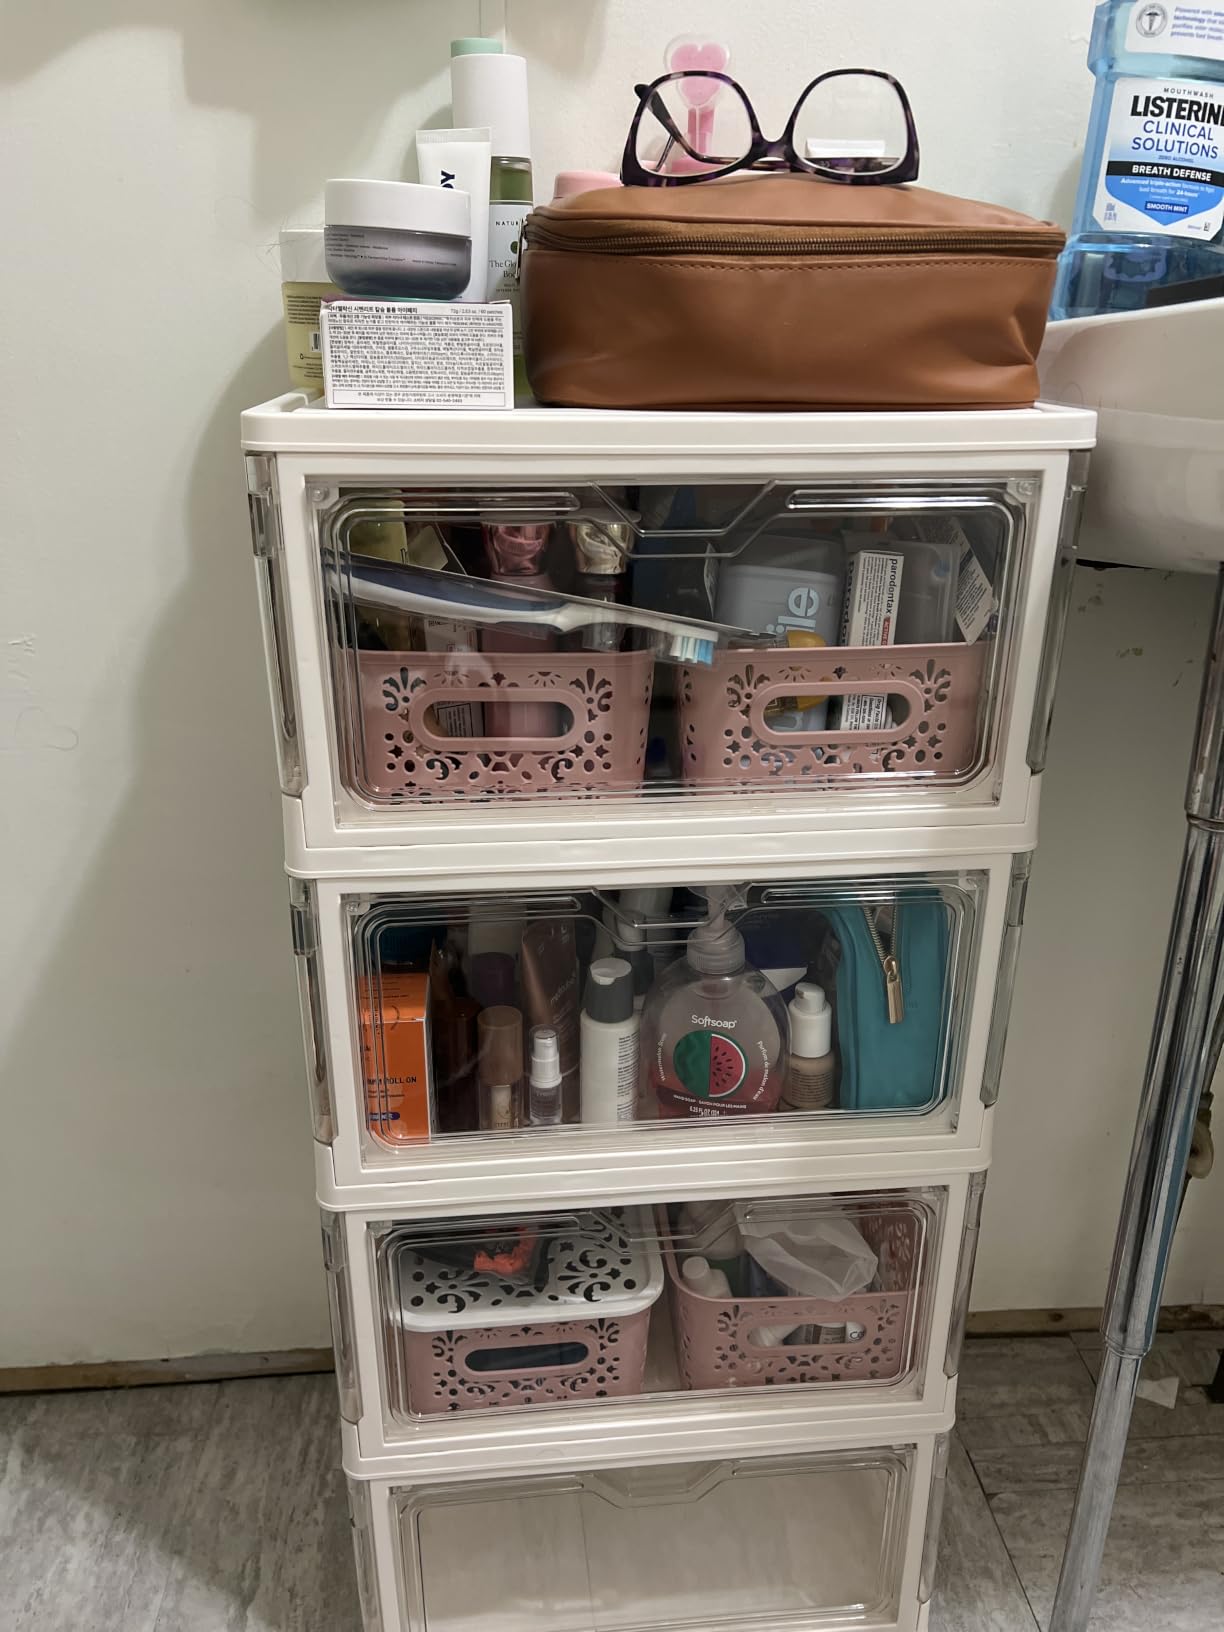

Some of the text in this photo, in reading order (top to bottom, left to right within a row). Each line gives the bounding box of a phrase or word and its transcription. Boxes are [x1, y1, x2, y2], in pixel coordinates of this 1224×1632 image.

[1163, 87, 1214, 99] MOUTHWASH
[1143, 120, 1214, 141] CLINICAL
[1131, 137, 1219, 160] SOLUTIONS
[1131, 165, 1213, 182] BREATH DEFENSE
[1146, 203, 1173, 212] SMOOTH
[489, 260, 504, 269] The
[886, 558, 898, 614] parodontax
[692, 1014, 737, 1030] Softsoap
